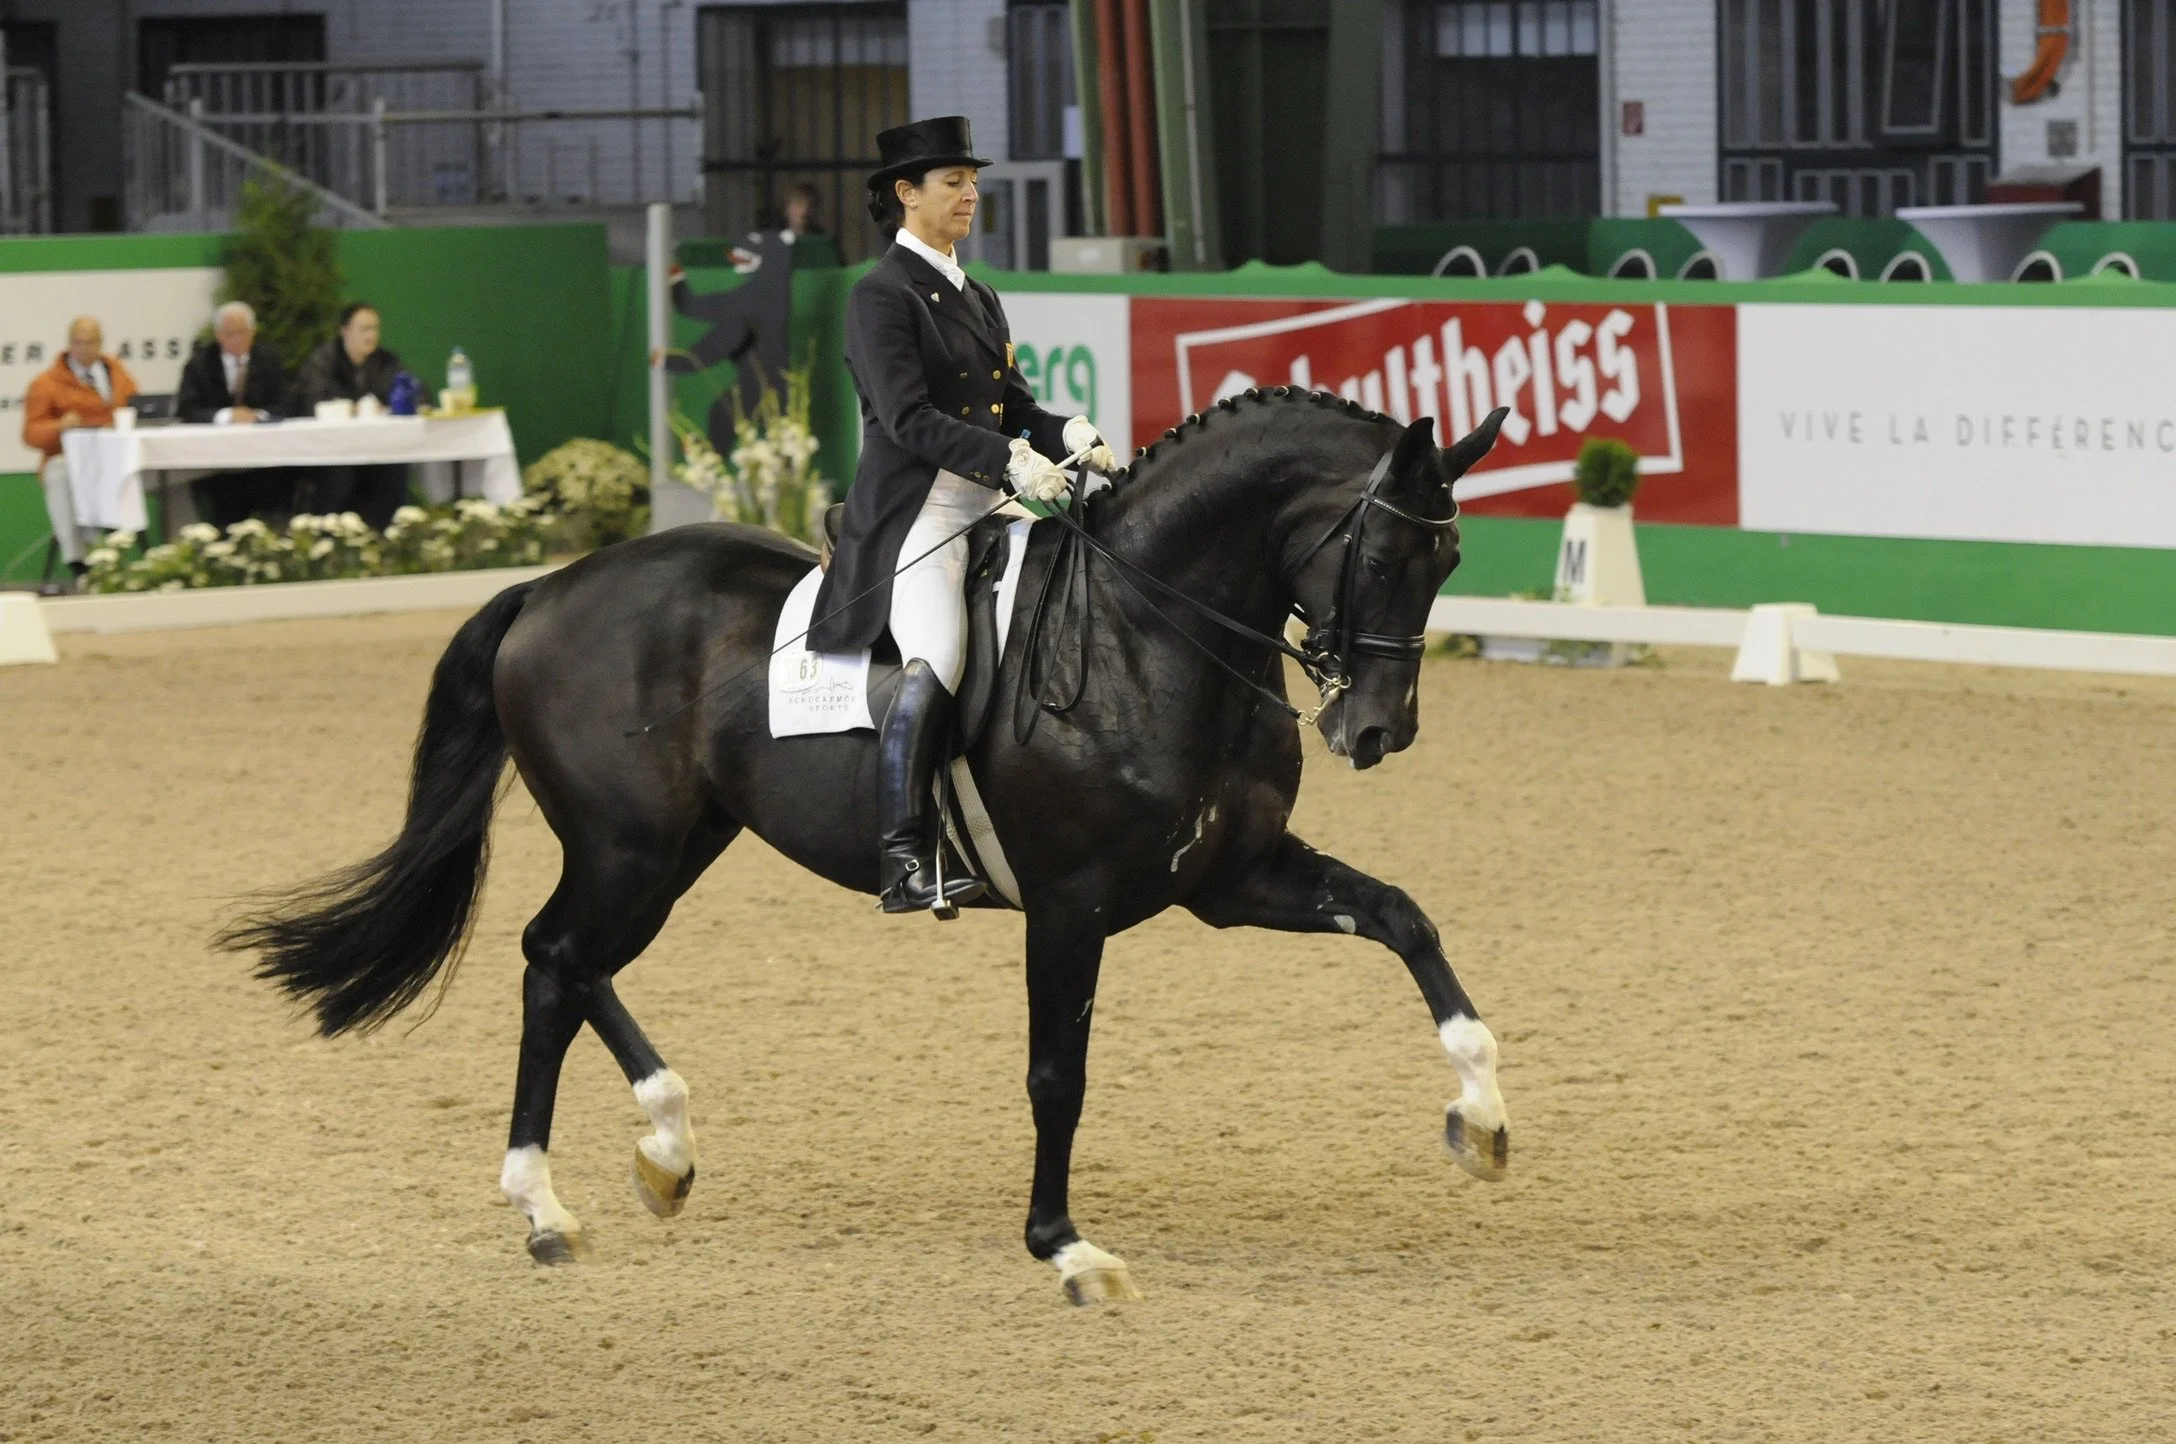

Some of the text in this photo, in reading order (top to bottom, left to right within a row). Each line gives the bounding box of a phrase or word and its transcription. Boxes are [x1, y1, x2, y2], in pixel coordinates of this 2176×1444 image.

[1780, 411, 1863, 444] VIVE
[1889, 412, 1929, 445] LA
[1563, 539, 1587, 584] M
